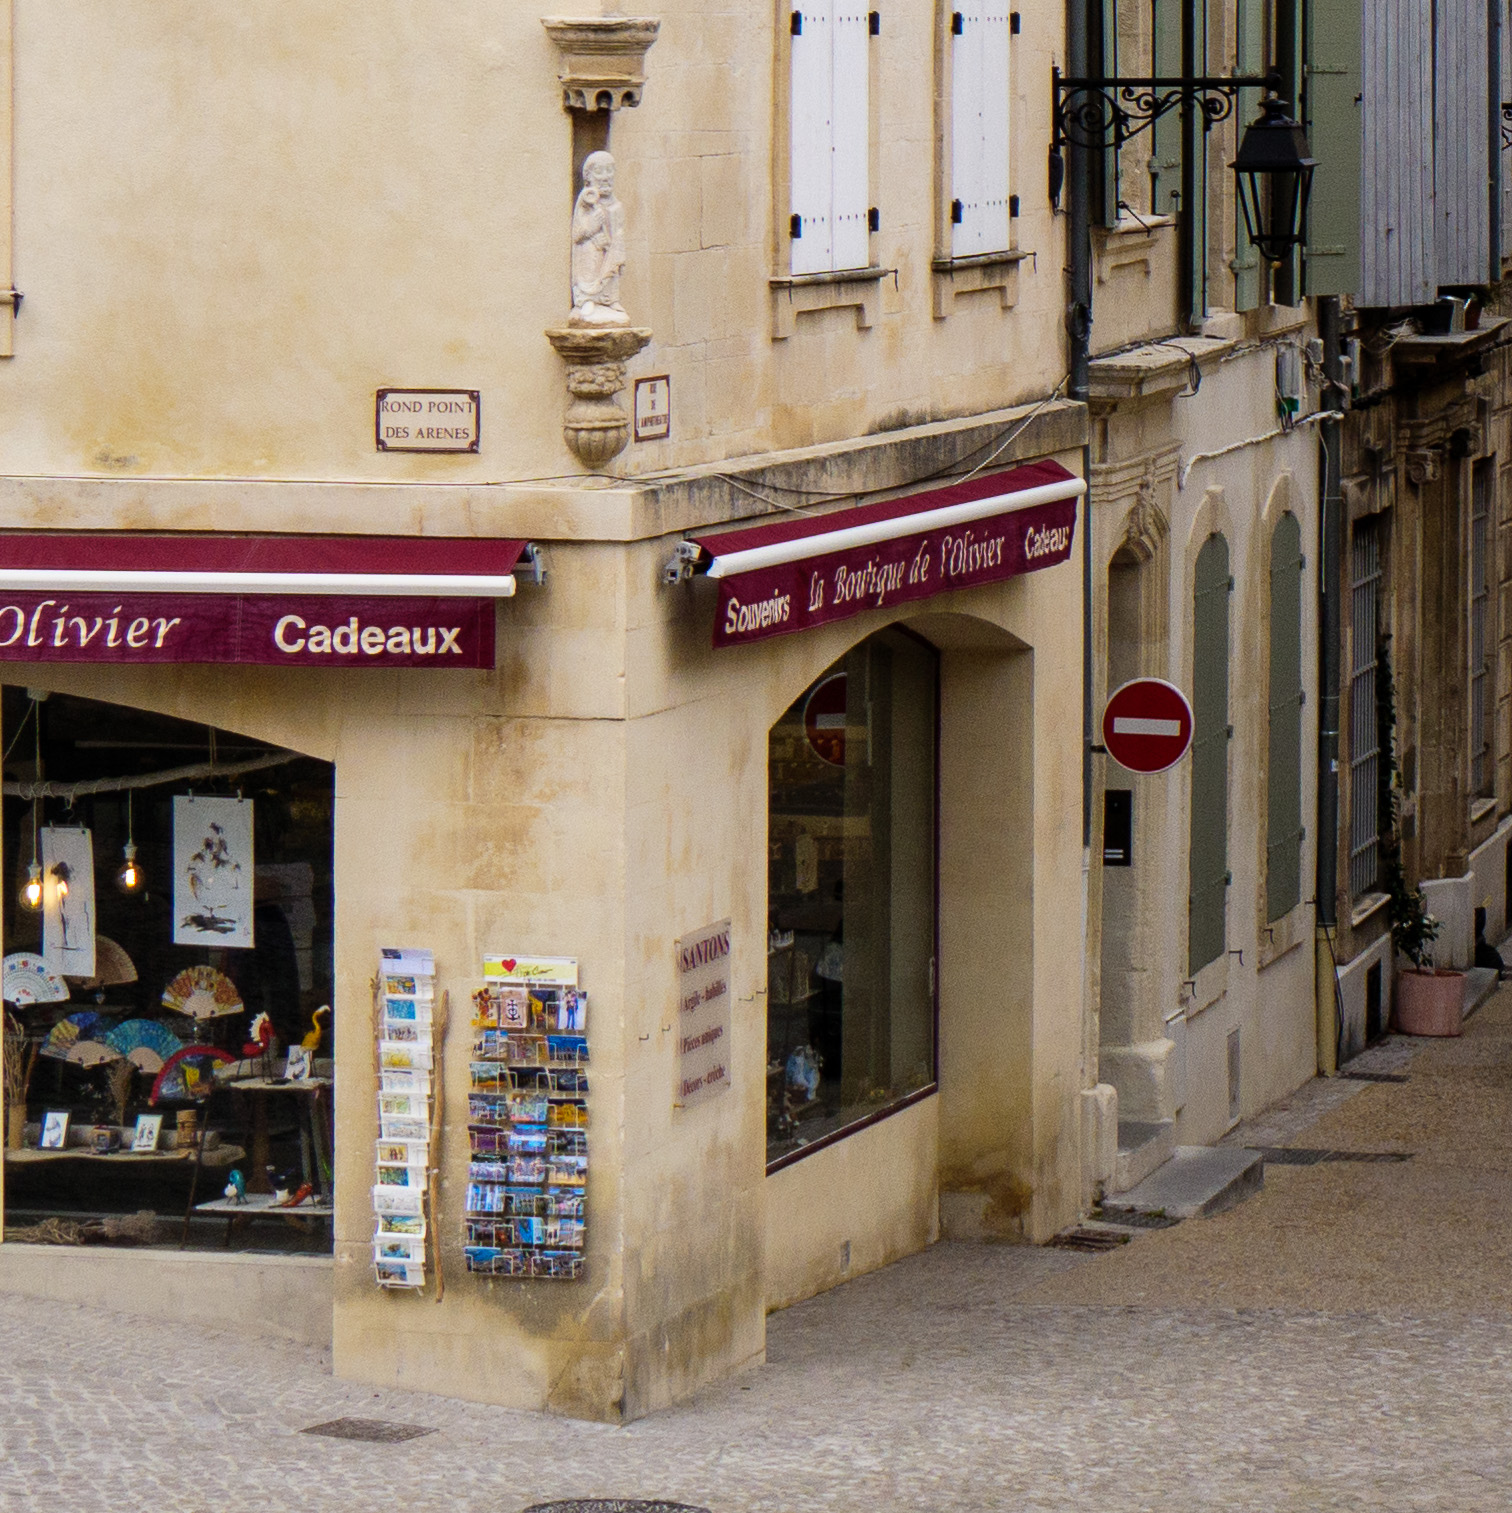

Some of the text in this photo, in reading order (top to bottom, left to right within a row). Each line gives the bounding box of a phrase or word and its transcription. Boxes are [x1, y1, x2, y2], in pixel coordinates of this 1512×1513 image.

[381, 400, 474, 414] ROND POINT
[385, 426, 470, 440] DES ARENES
[725, 588, 790, 635] Souvenirs
[808, 570, 825, 612] La
[833, 555, 905, 608] Boutique
[909, 540, 931, 585] de
[940, 531, 1005, 579] l'Olivier
[274, 614, 463, 655] Cadeaux
[681, 930, 731, 973] SANTONS
